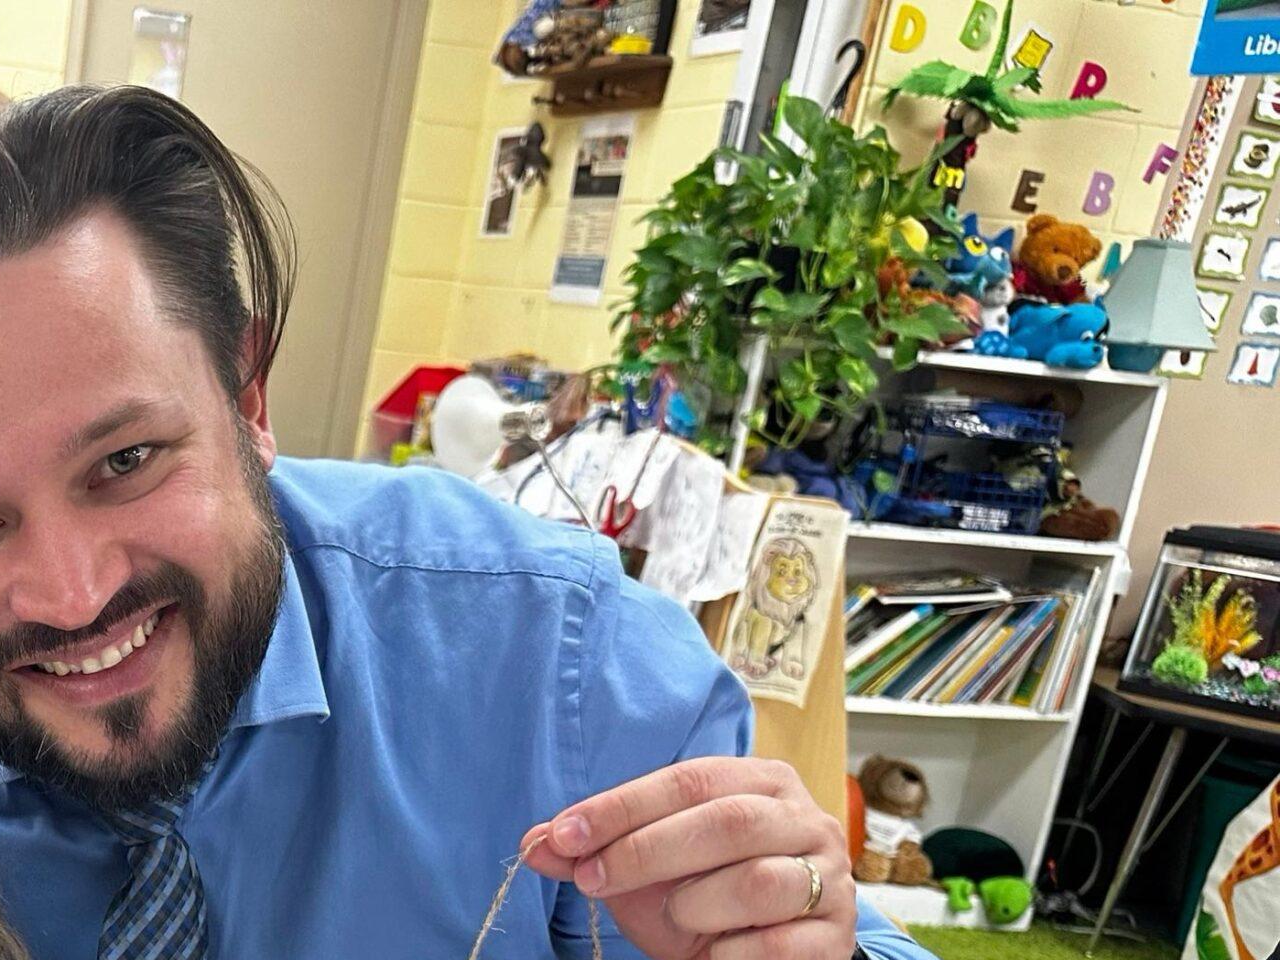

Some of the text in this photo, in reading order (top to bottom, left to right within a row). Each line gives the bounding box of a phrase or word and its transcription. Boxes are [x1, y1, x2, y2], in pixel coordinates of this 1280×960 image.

[889, 4, 927, 53] D
[959, 0, 997, 51] B
[1011, 143, 1179, 216] E B F
